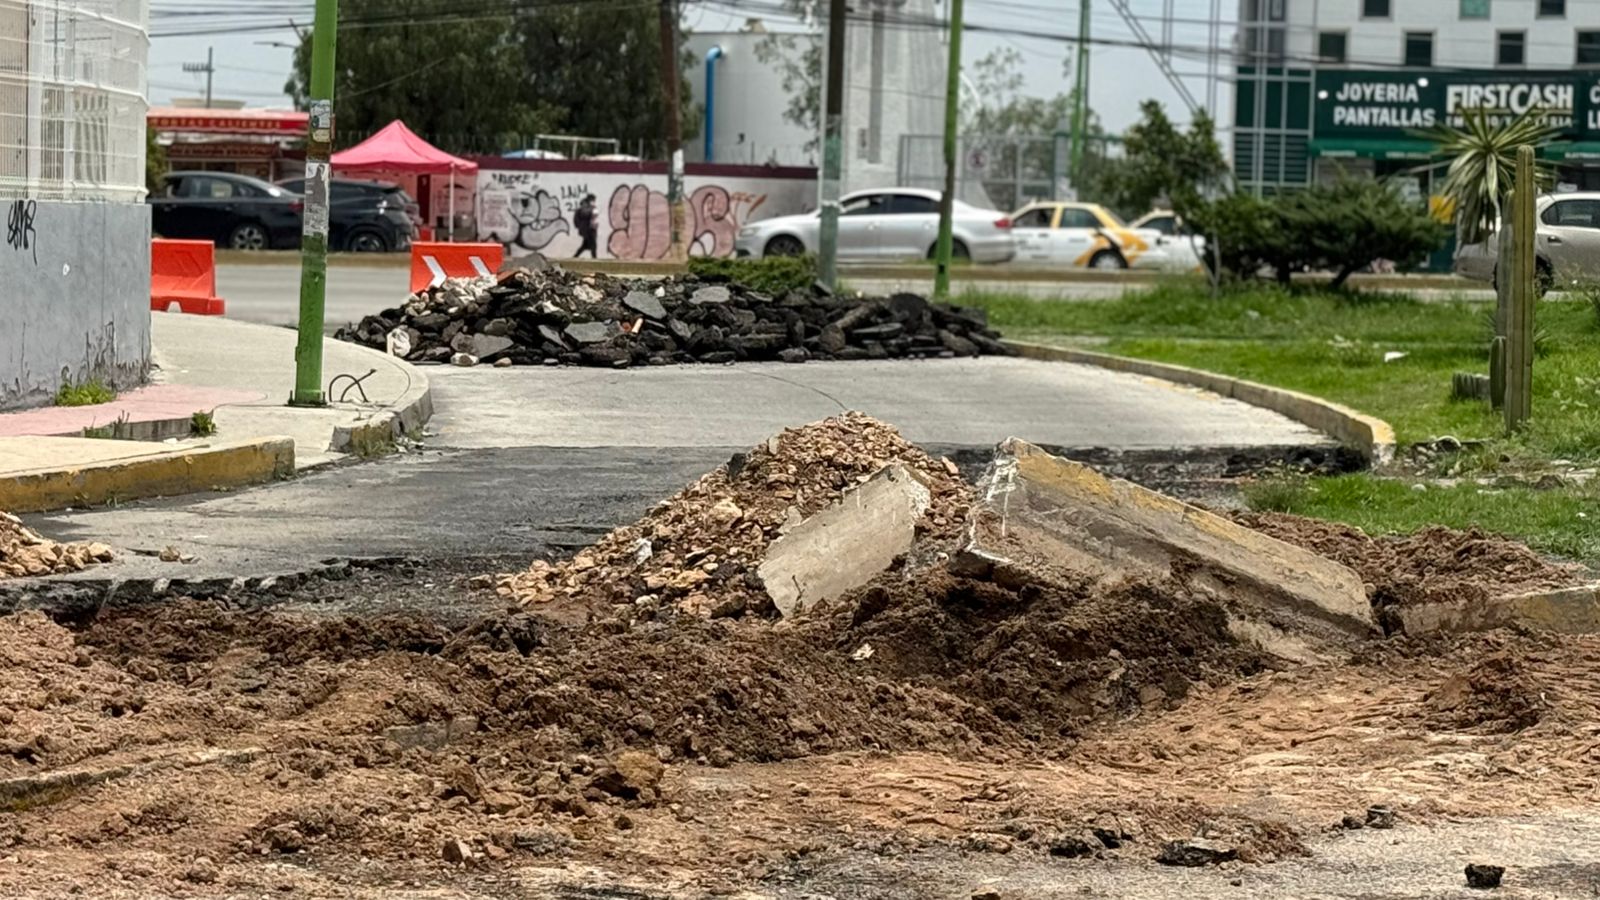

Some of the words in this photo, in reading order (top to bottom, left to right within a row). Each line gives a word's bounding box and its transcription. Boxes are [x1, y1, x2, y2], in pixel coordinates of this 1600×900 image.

[1336, 82, 1419, 103] JOYERIA
[1446, 84, 1574, 114] FIRSTCASH
[1333, 106, 1436, 128] PANTALLAS
